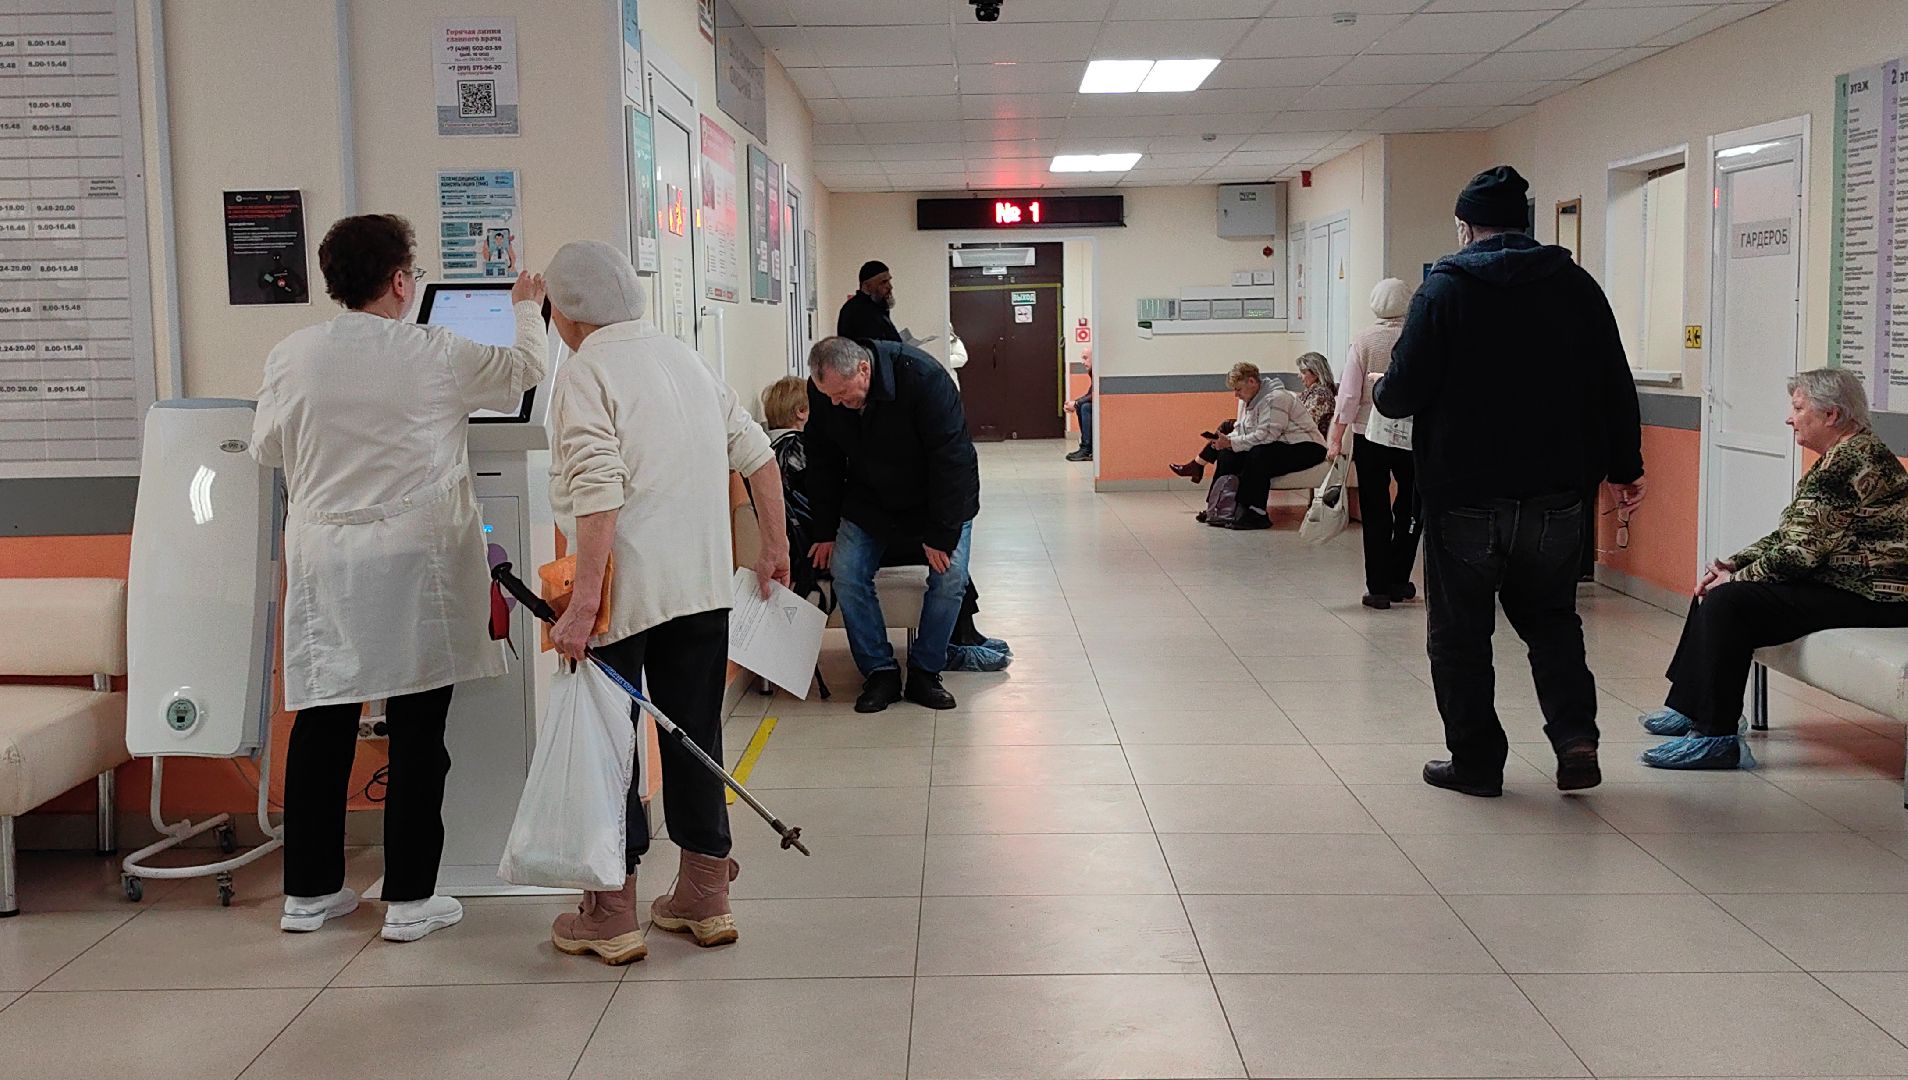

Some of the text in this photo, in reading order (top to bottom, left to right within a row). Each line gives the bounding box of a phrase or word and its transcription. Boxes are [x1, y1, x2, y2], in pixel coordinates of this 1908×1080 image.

[1891, 69, 1897, 85] 2
[1850, 80, 1869, 95] этаж
[996, 202, 1040, 223] № 1
[1740, 229, 1788, 249] ГАРДЕРОБ
